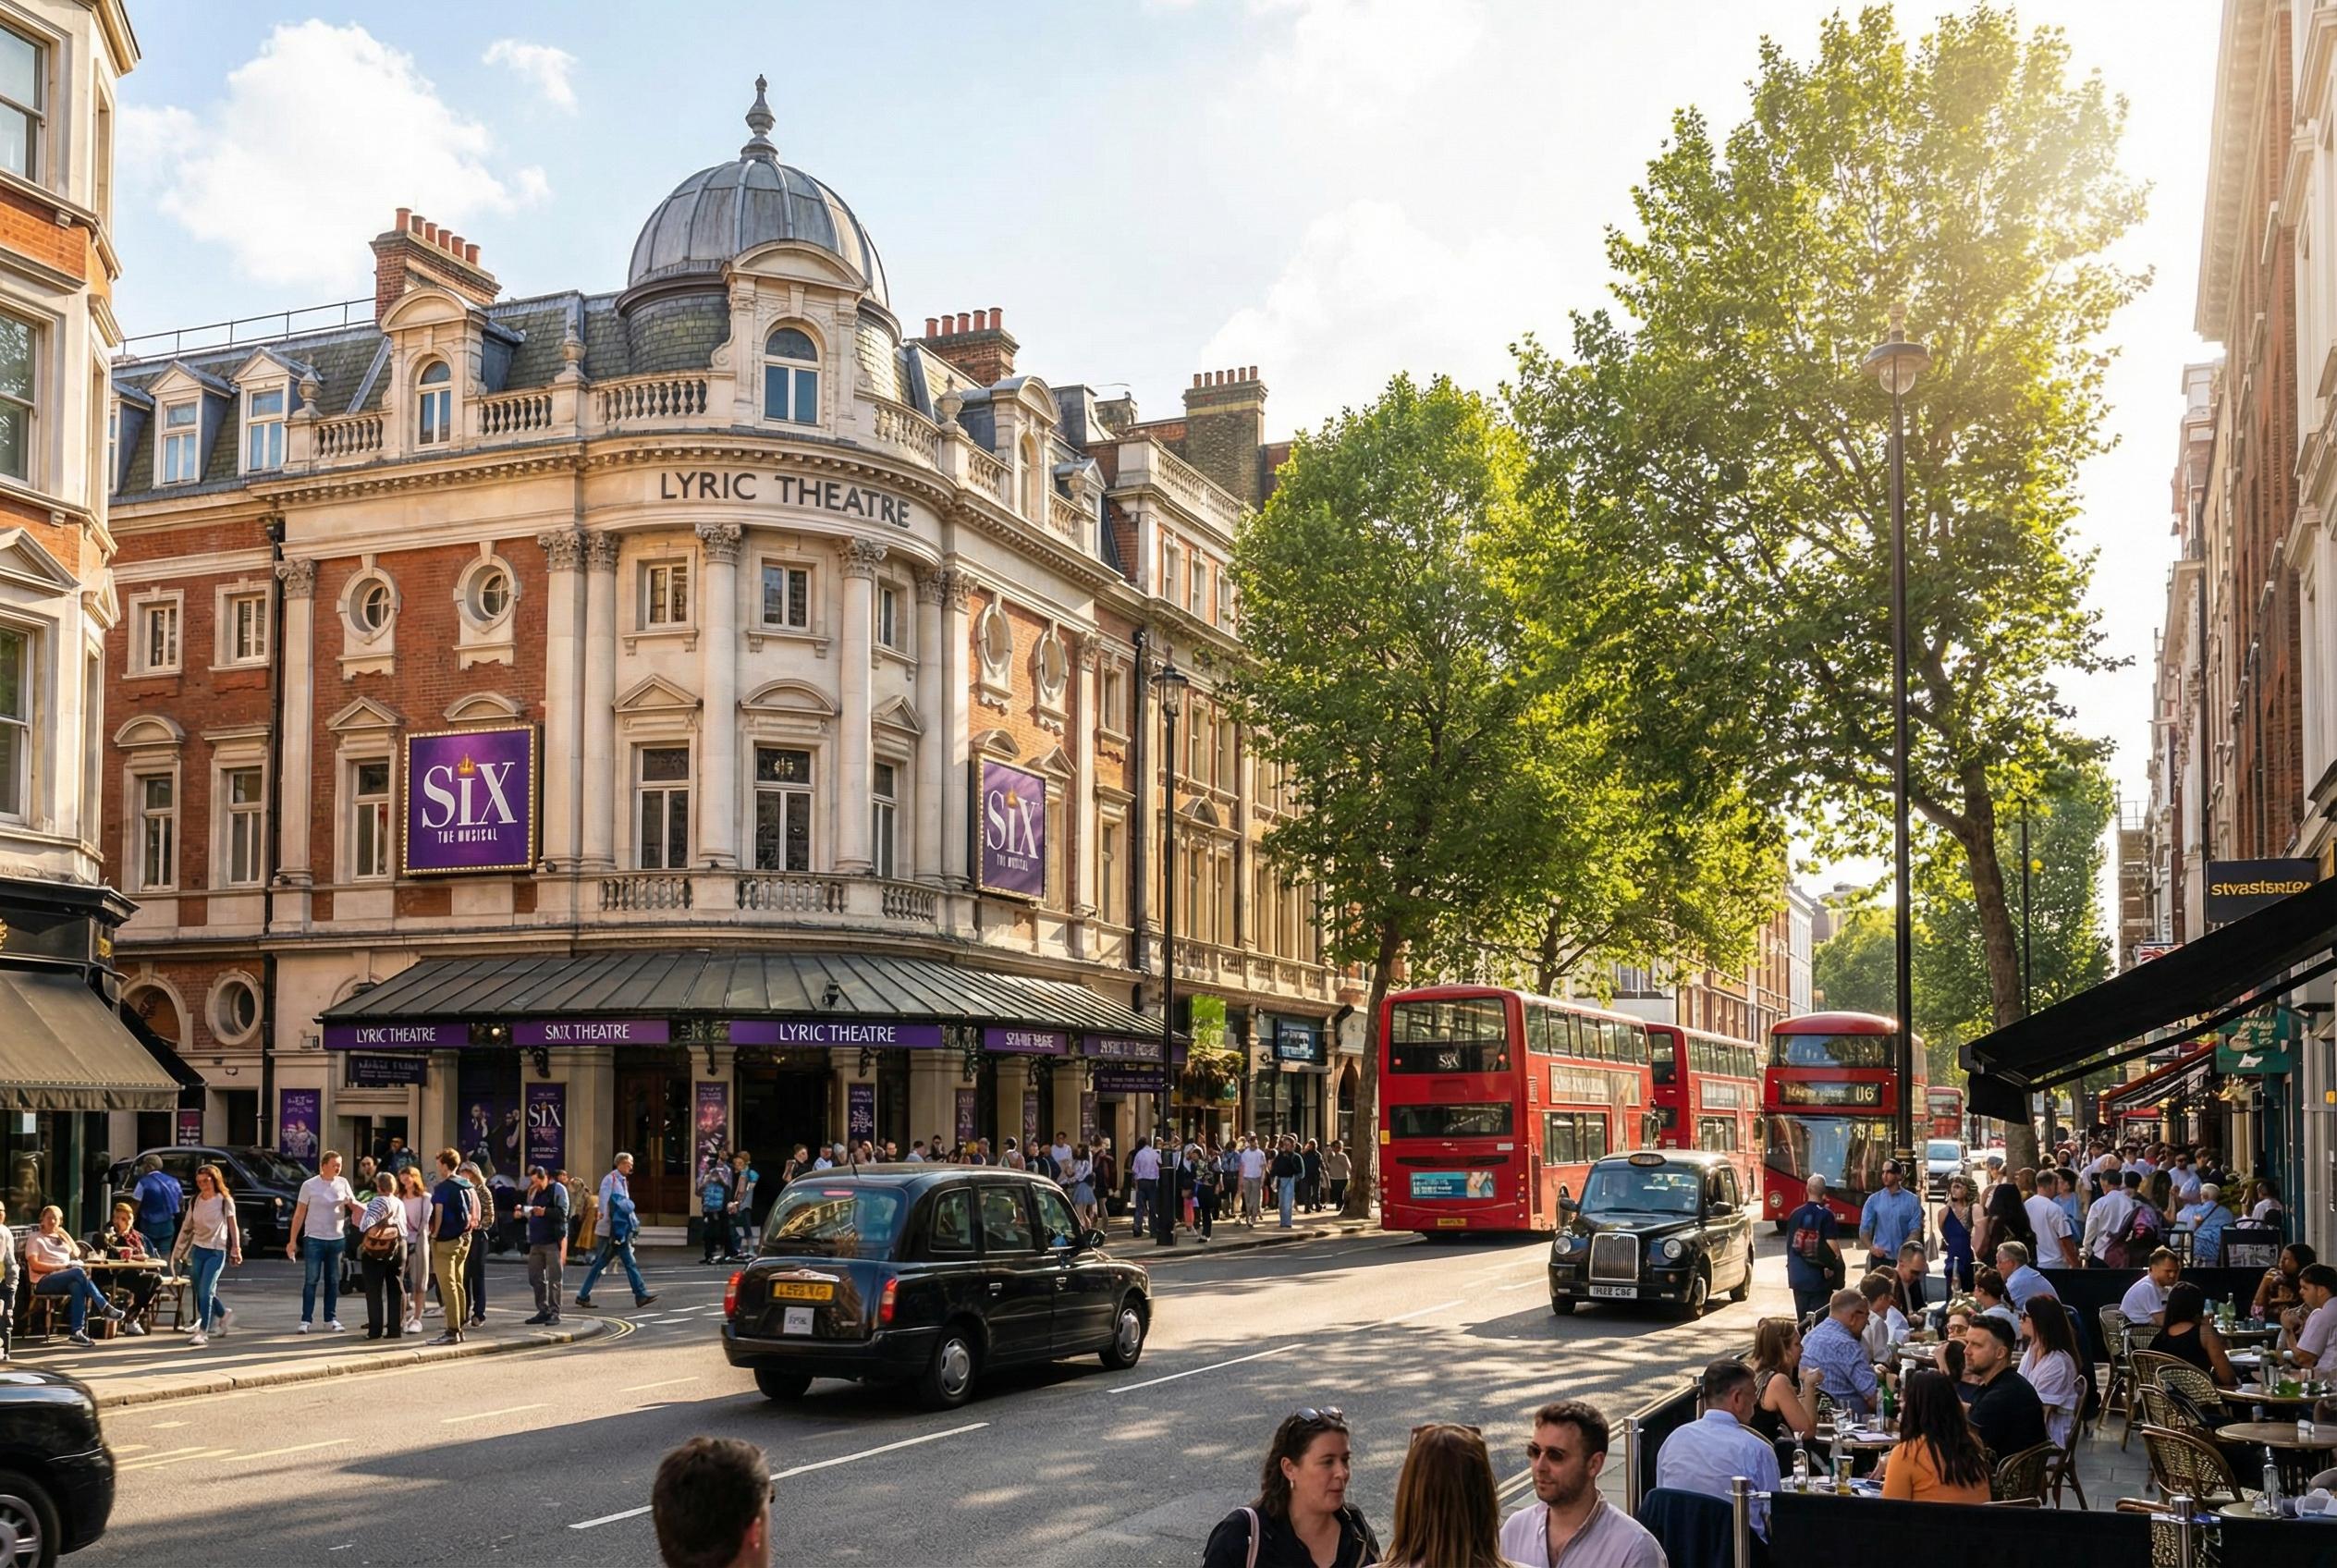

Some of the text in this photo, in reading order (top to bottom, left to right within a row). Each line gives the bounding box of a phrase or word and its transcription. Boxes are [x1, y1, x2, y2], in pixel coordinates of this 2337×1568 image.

[661, 472, 911, 529] LYRIC THEATRE
[422, 762, 519, 829] SIX
[986, 790, 1040, 860] SIX
[356, 1026, 436, 1044] LYRIC THEATRE
[573, 1023, 630, 1040] THEATRE
[779, 1023, 897, 1043] LYRIC THEATRE
[528, 1103, 562, 1128] SIX
